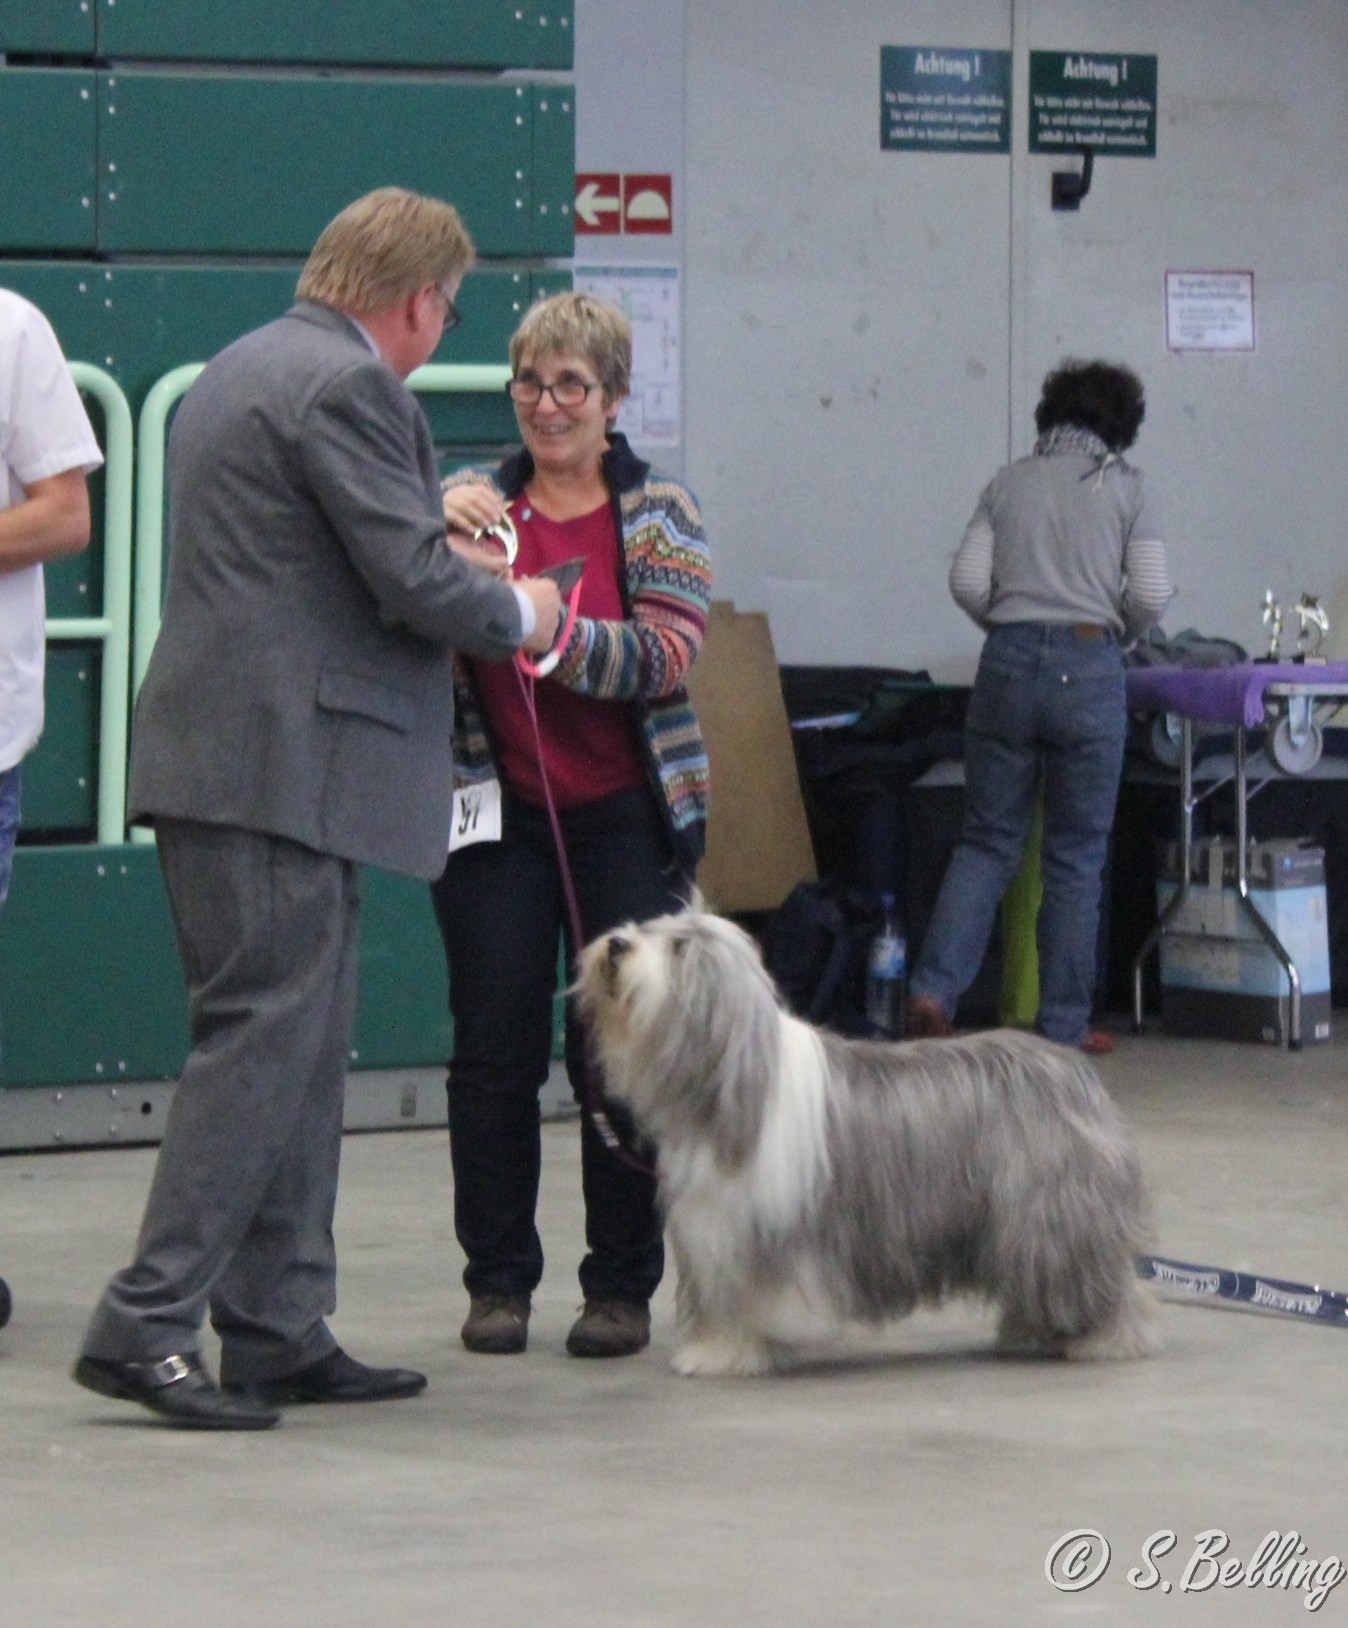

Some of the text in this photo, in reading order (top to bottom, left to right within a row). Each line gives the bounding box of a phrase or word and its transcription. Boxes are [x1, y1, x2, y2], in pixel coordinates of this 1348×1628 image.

[914, 53, 981, 82] Achtung !
[1063, 56, 1128, 87] Achtung !
